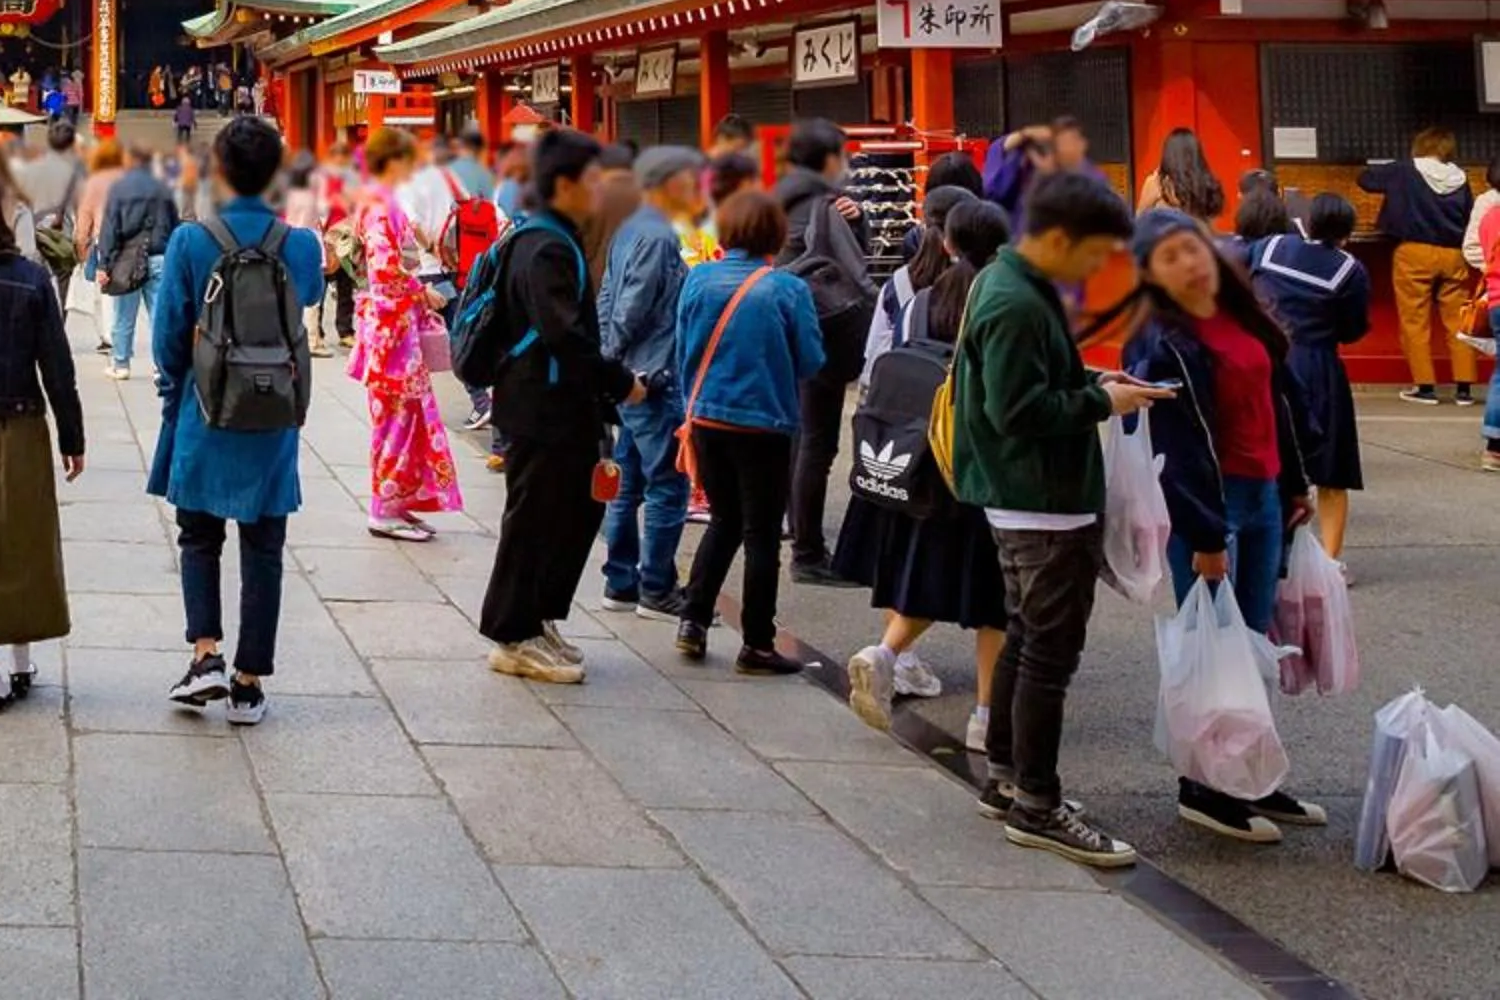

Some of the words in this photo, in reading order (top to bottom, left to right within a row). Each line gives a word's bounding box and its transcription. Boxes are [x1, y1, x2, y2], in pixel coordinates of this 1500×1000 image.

[917, 3, 995, 36] 朱印所
[803, 32, 852, 73] みくじ
[856, 475, 909, 501] adidas
